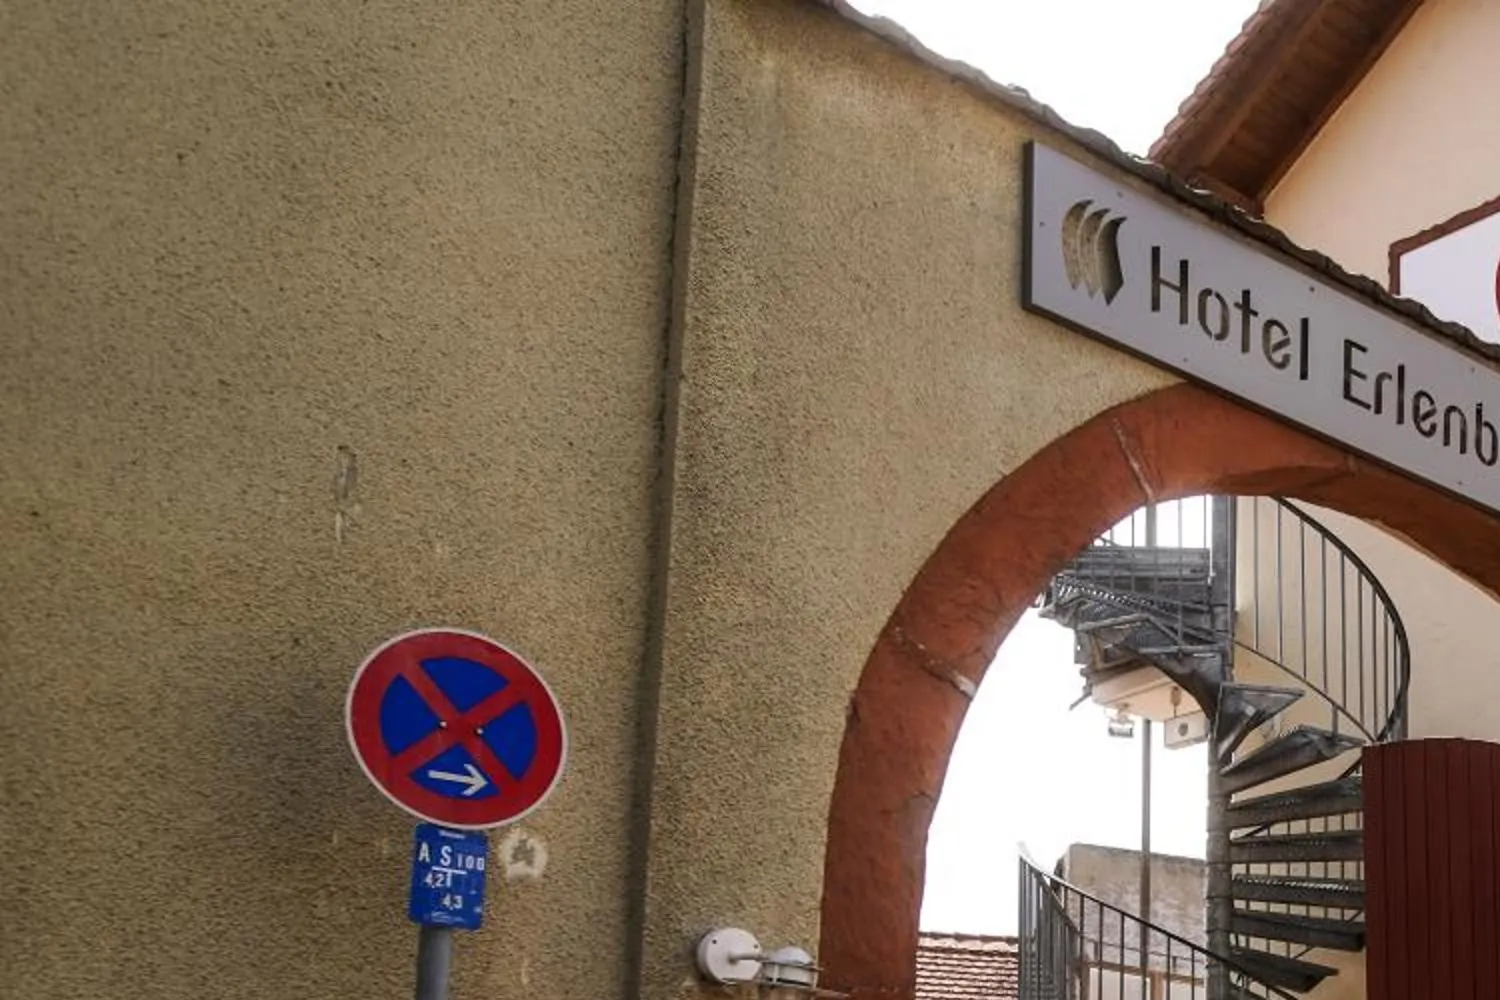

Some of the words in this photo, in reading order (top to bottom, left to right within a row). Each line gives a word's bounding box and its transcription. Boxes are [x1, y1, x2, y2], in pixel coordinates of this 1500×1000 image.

[1151, 246, 1309, 380] Hotel
[418, 841, 431, 862] A
[440, 845, 453, 867] S
